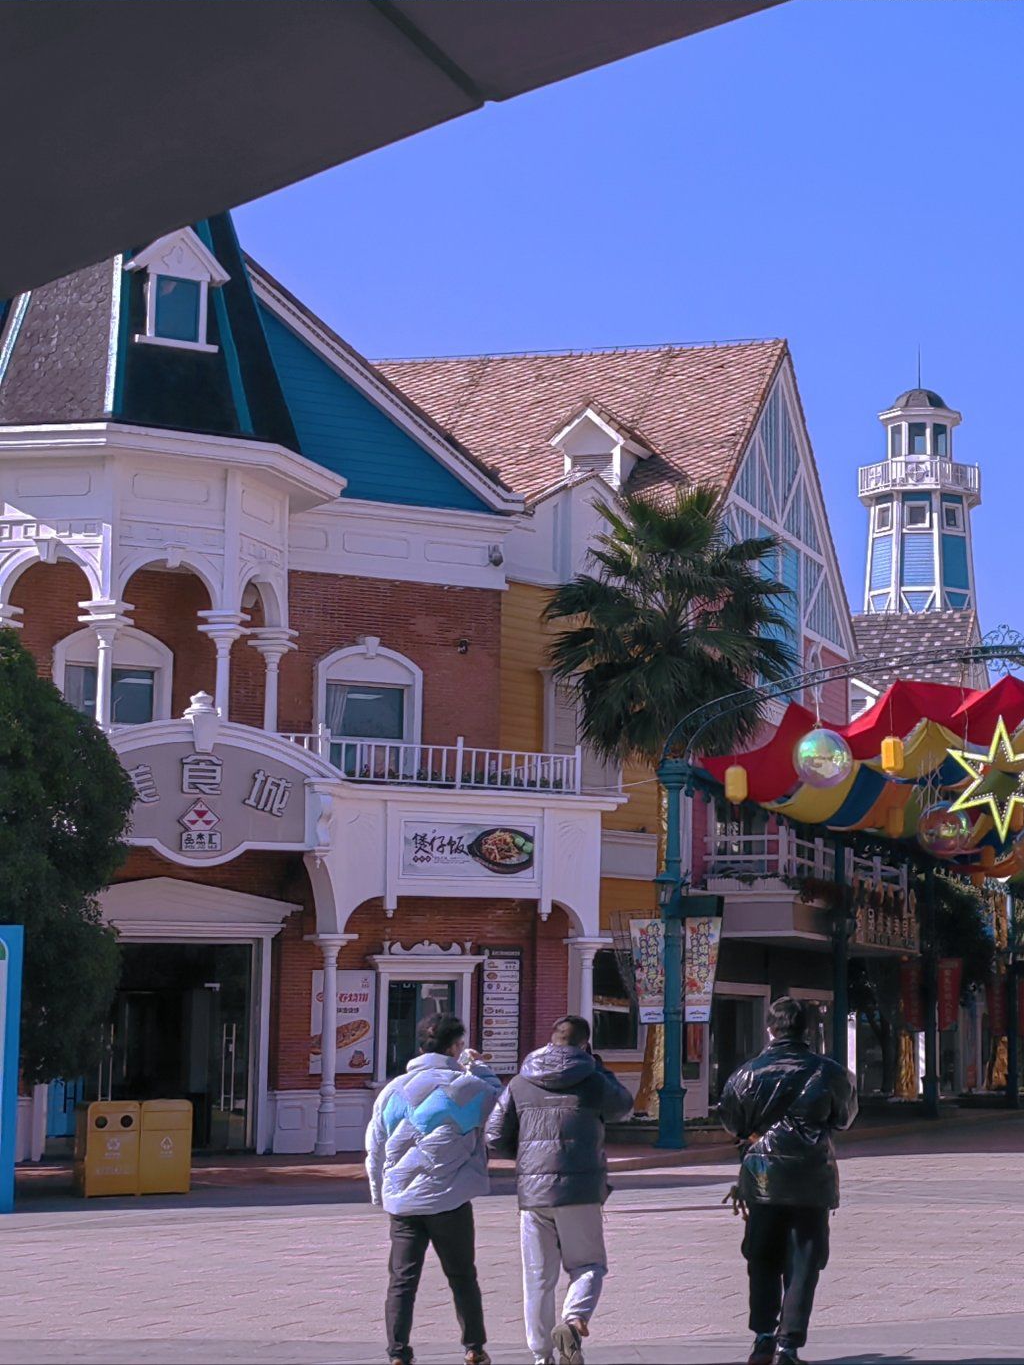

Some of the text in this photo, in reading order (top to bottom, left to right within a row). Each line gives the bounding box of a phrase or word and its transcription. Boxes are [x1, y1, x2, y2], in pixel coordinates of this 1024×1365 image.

[129, 753, 293, 818] 美食城
[412, 832, 469, 856] 煲仔饭
